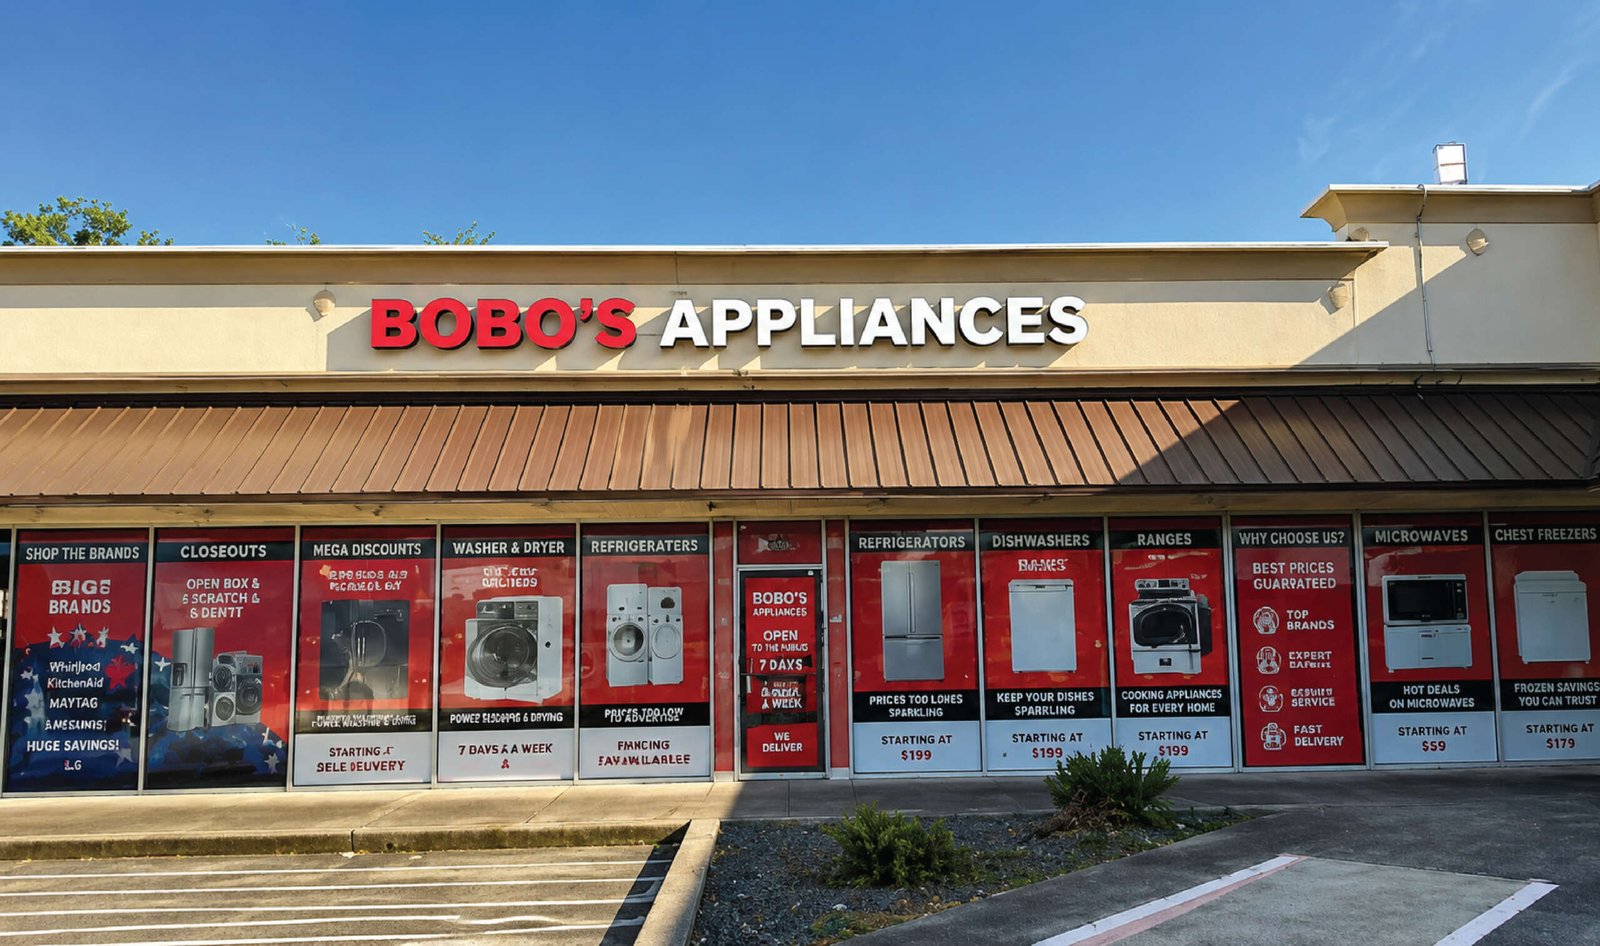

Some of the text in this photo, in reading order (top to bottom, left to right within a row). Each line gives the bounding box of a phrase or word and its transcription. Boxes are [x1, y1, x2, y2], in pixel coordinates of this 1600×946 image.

[370, 295, 1090, 350] BOBO'S APPLIANCES
[1137, 533, 1192, 546] RANGES
[1239, 531, 1345, 545] WHY CHOOSE US?
[1375, 529, 1468, 543] MICROWAVES
[1495, 527, 1597, 542] CHEST FREEZERS
[591, 539, 698, 553] REFRIGERATERS
[858, 535, 966, 549] REFRIGERATORS
[992, 534, 1090, 548] DISHWASHERS
[26, 546, 140, 561] SHOP THE BRANDS
[180, 545, 267, 558] CLOSEOUTS
[313, 543, 421, 556] MEGA DISCOUNTS
[453, 541, 565, 555] WASHER & DRYER
[1252, 562, 1334, 575] BEST PRICES
[186, 577, 260, 590] OPEN BOX &
[191, 592, 248, 604] SCRATCH
[752, 591, 807, 605] BOBO'S
[49, 599, 111, 615] BRANDS
[752, 607, 807, 617] APPLIANCES
[1286, 609, 1309, 620] TOP
[1286, 620, 1335, 631] BRANDS
[763, 630, 798, 641] OPEN
[751, 643, 763, 652] TO
[1288, 651, 1333, 660] EXPERT
[759, 659, 767, 671] 7
[47, 677, 104, 689] KitchenAid
[1514, 681, 1600, 693] FROZEN SAVINGS
[1121, 689, 1223, 700] COOKING APPLIANCES
[1403, 684, 1460, 695] HOT DEALS
[49, 697, 98, 709] MAYTAG
[869, 695, 906, 706] PRICES
[908, 694, 929, 705] TOO
[996, 691, 1095, 703] KEEP YOUR DISHES
[1291, 697, 1336, 707] SERVICE
[1389, 697, 1475, 709] ON MICROWAVES
[1518, 695, 1598, 707] YOU CAN TRUST
[1129, 702, 1216, 714] FOR EVERY HOME
[1293, 724, 1323, 734] FAST
[1398, 725, 1468, 736] STARTING AT
[1525, 723, 1595, 734] STARTING AT
[774, 732, 790, 742] WE
[881, 734, 953, 745] STARTING AT
[1012, 732, 1083, 743] STARTING AT
[1138, 730, 1208, 741] STARTING AT
[1294, 736, 1344, 747] DELIVERY
[27, 739, 120, 752] HUGE SAVINGS!
[458, 745, 466, 756] 7
[511, 744, 519, 754] A
[521, 743, 553, 754] WEEK
[762, 743, 803, 753] DELIVER
[1422, 741, 1447, 752] $59
[1546, 738, 1576, 750] $179
[329, 746, 381, 757] STARTING
[901, 749, 932, 761] $199
[1032, 747, 1063, 759] $199
[1158, 745, 1189, 757] $199
[64, 759, 82, 771] LG
